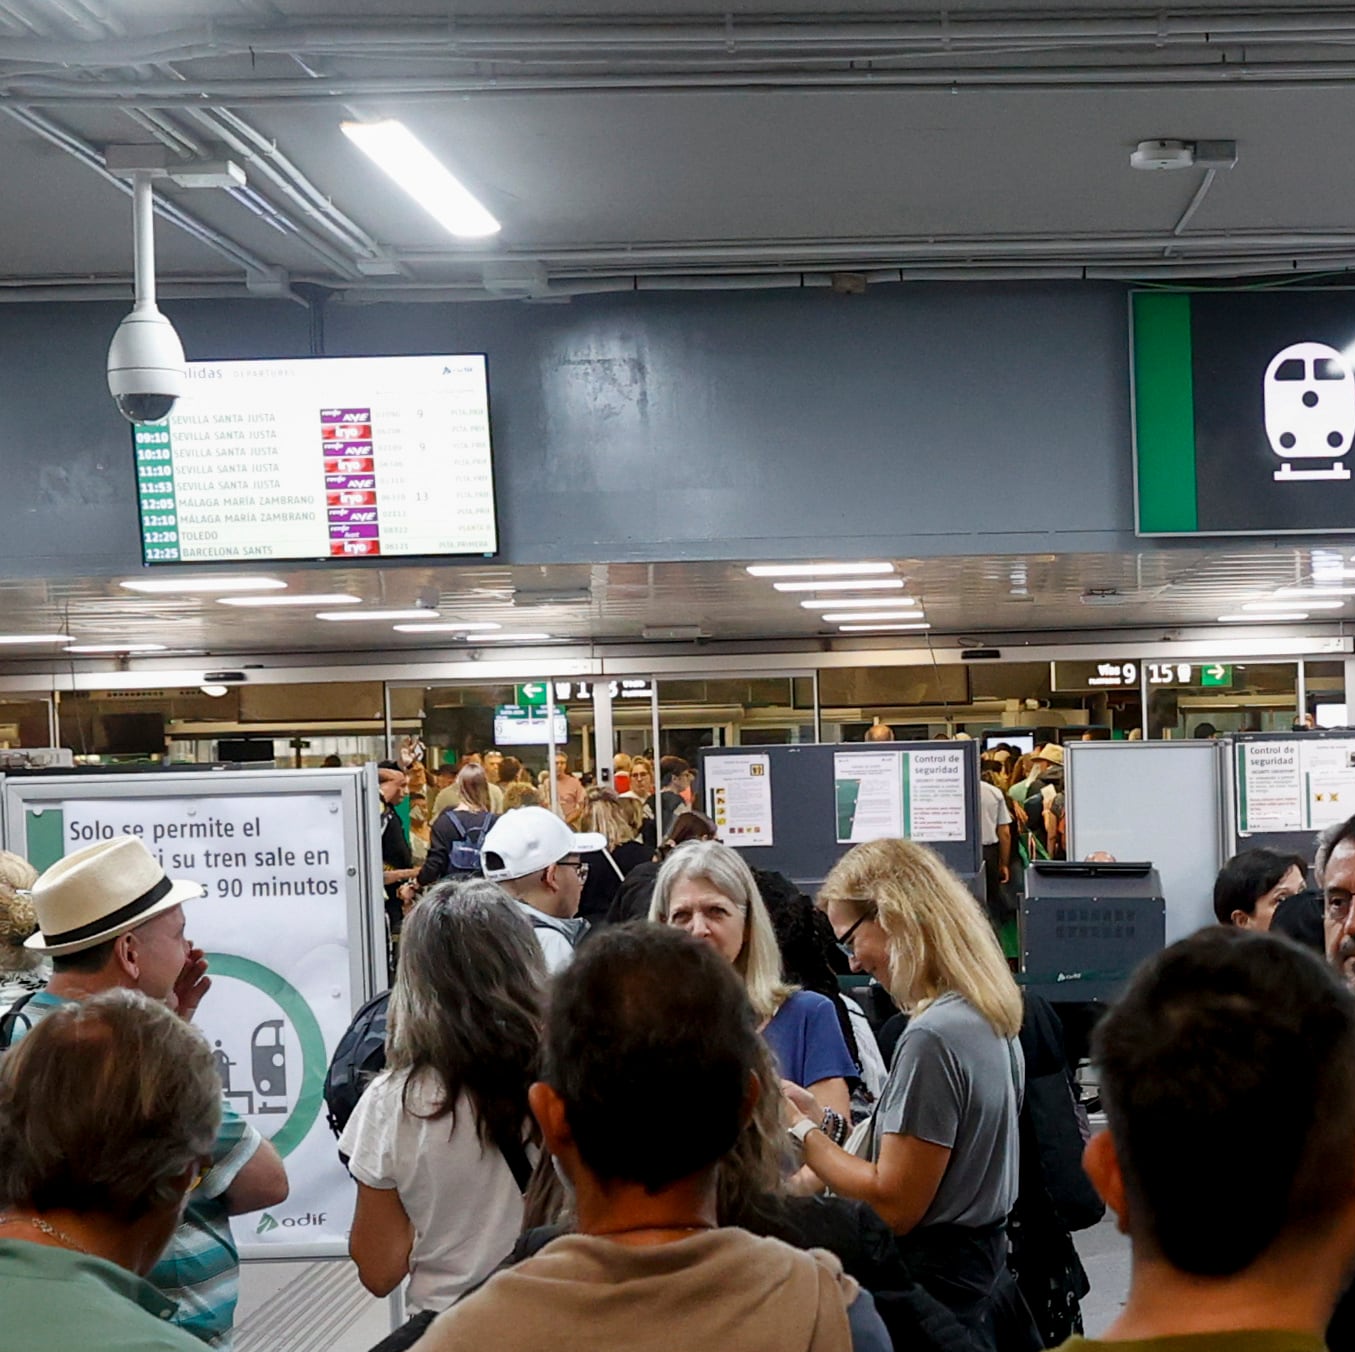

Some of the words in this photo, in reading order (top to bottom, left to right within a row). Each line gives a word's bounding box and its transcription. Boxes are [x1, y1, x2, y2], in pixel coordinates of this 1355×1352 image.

[184, 368, 223, 379] lidas
[171, 416, 209, 425] SEVILLA
[213, 414, 244, 423] SANTA
[248, 413, 276, 422] JUSTA
[342, 413, 369, 422] AVE
[136, 432, 169, 443] 09:10
[173, 432, 210, 441] SEVILLA
[214, 431, 245, 440] SANTA
[250, 430, 277, 439] JUSTA
[335, 426, 359, 438] iryo
[138, 449, 170, 460] 10:10
[174, 449, 212, 458] SEVILLA
[216, 448, 246, 457] SANTA
[251, 447, 278, 456] JUSTA
[345, 446, 372, 456] AVE
[139, 465, 171, 476] 11:10
[176, 465, 213, 474] SEVILLA
[217, 465, 248, 473] SANTA
[252, 464, 279, 472] JUSTA
[338, 459, 361, 472] iryo
[140, 482, 172, 493] 11:53
[177, 482, 214, 491] SEVILLA
[218, 481, 249, 490] SANTA
[253, 480, 281, 489] JUSTA
[347, 479, 374, 489] AVE
[142, 499, 174, 509] 12:05
[179, 497, 220, 507] MÁLAGA
[223, 496, 255, 506] MARÍA
[259, 495, 315, 505] ZAMBRANO
[340, 492, 364, 505] iryo
[143, 515, 176, 526] 12:10
[180, 514, 221, 524] MÁLAGA
[225, 512, 256, 522] MARÍA
[261, 512, 316, 521] ZAMBRANO
[350, 512, 376, 522] AVE
[145, 532, 177, 542] 12:20
[181, 531, 218, 540] TOLEDO
[146, 548, 178, 559] 12:25
[183, 547, 239, 557] BARCELONA
[243, 546, 273, 555] SANTS
[344, 541, 367, 554] iryo
[1122, 663, 1137, 684] 9
[1148, 664, 1173, 684] 15
[1250, 746, 1281, 755] Control
[1284, 745, 1294, 754] de
[914, 755, 946, 763] Control
[948, 754, 960, 763] de
[1251, 757, 1294, 767] seguridad
[915, 766, 959, 776] seguridad
[69, 821, 114, 842] Solo
[123, 824, 144, 838] se
[153, 817, 235, 843] permite
[243, 817, 261, 837] el
[173, 853, 195, 869] su
[204, 850, 247, 869] tren
[255, 848, 295, 867] sale
[304, 851, 330, 866] en
[218, 878, 243, 898] 90
[252, 876, 339, 897] minutos
[281, 1212, 327, 1227] adif
